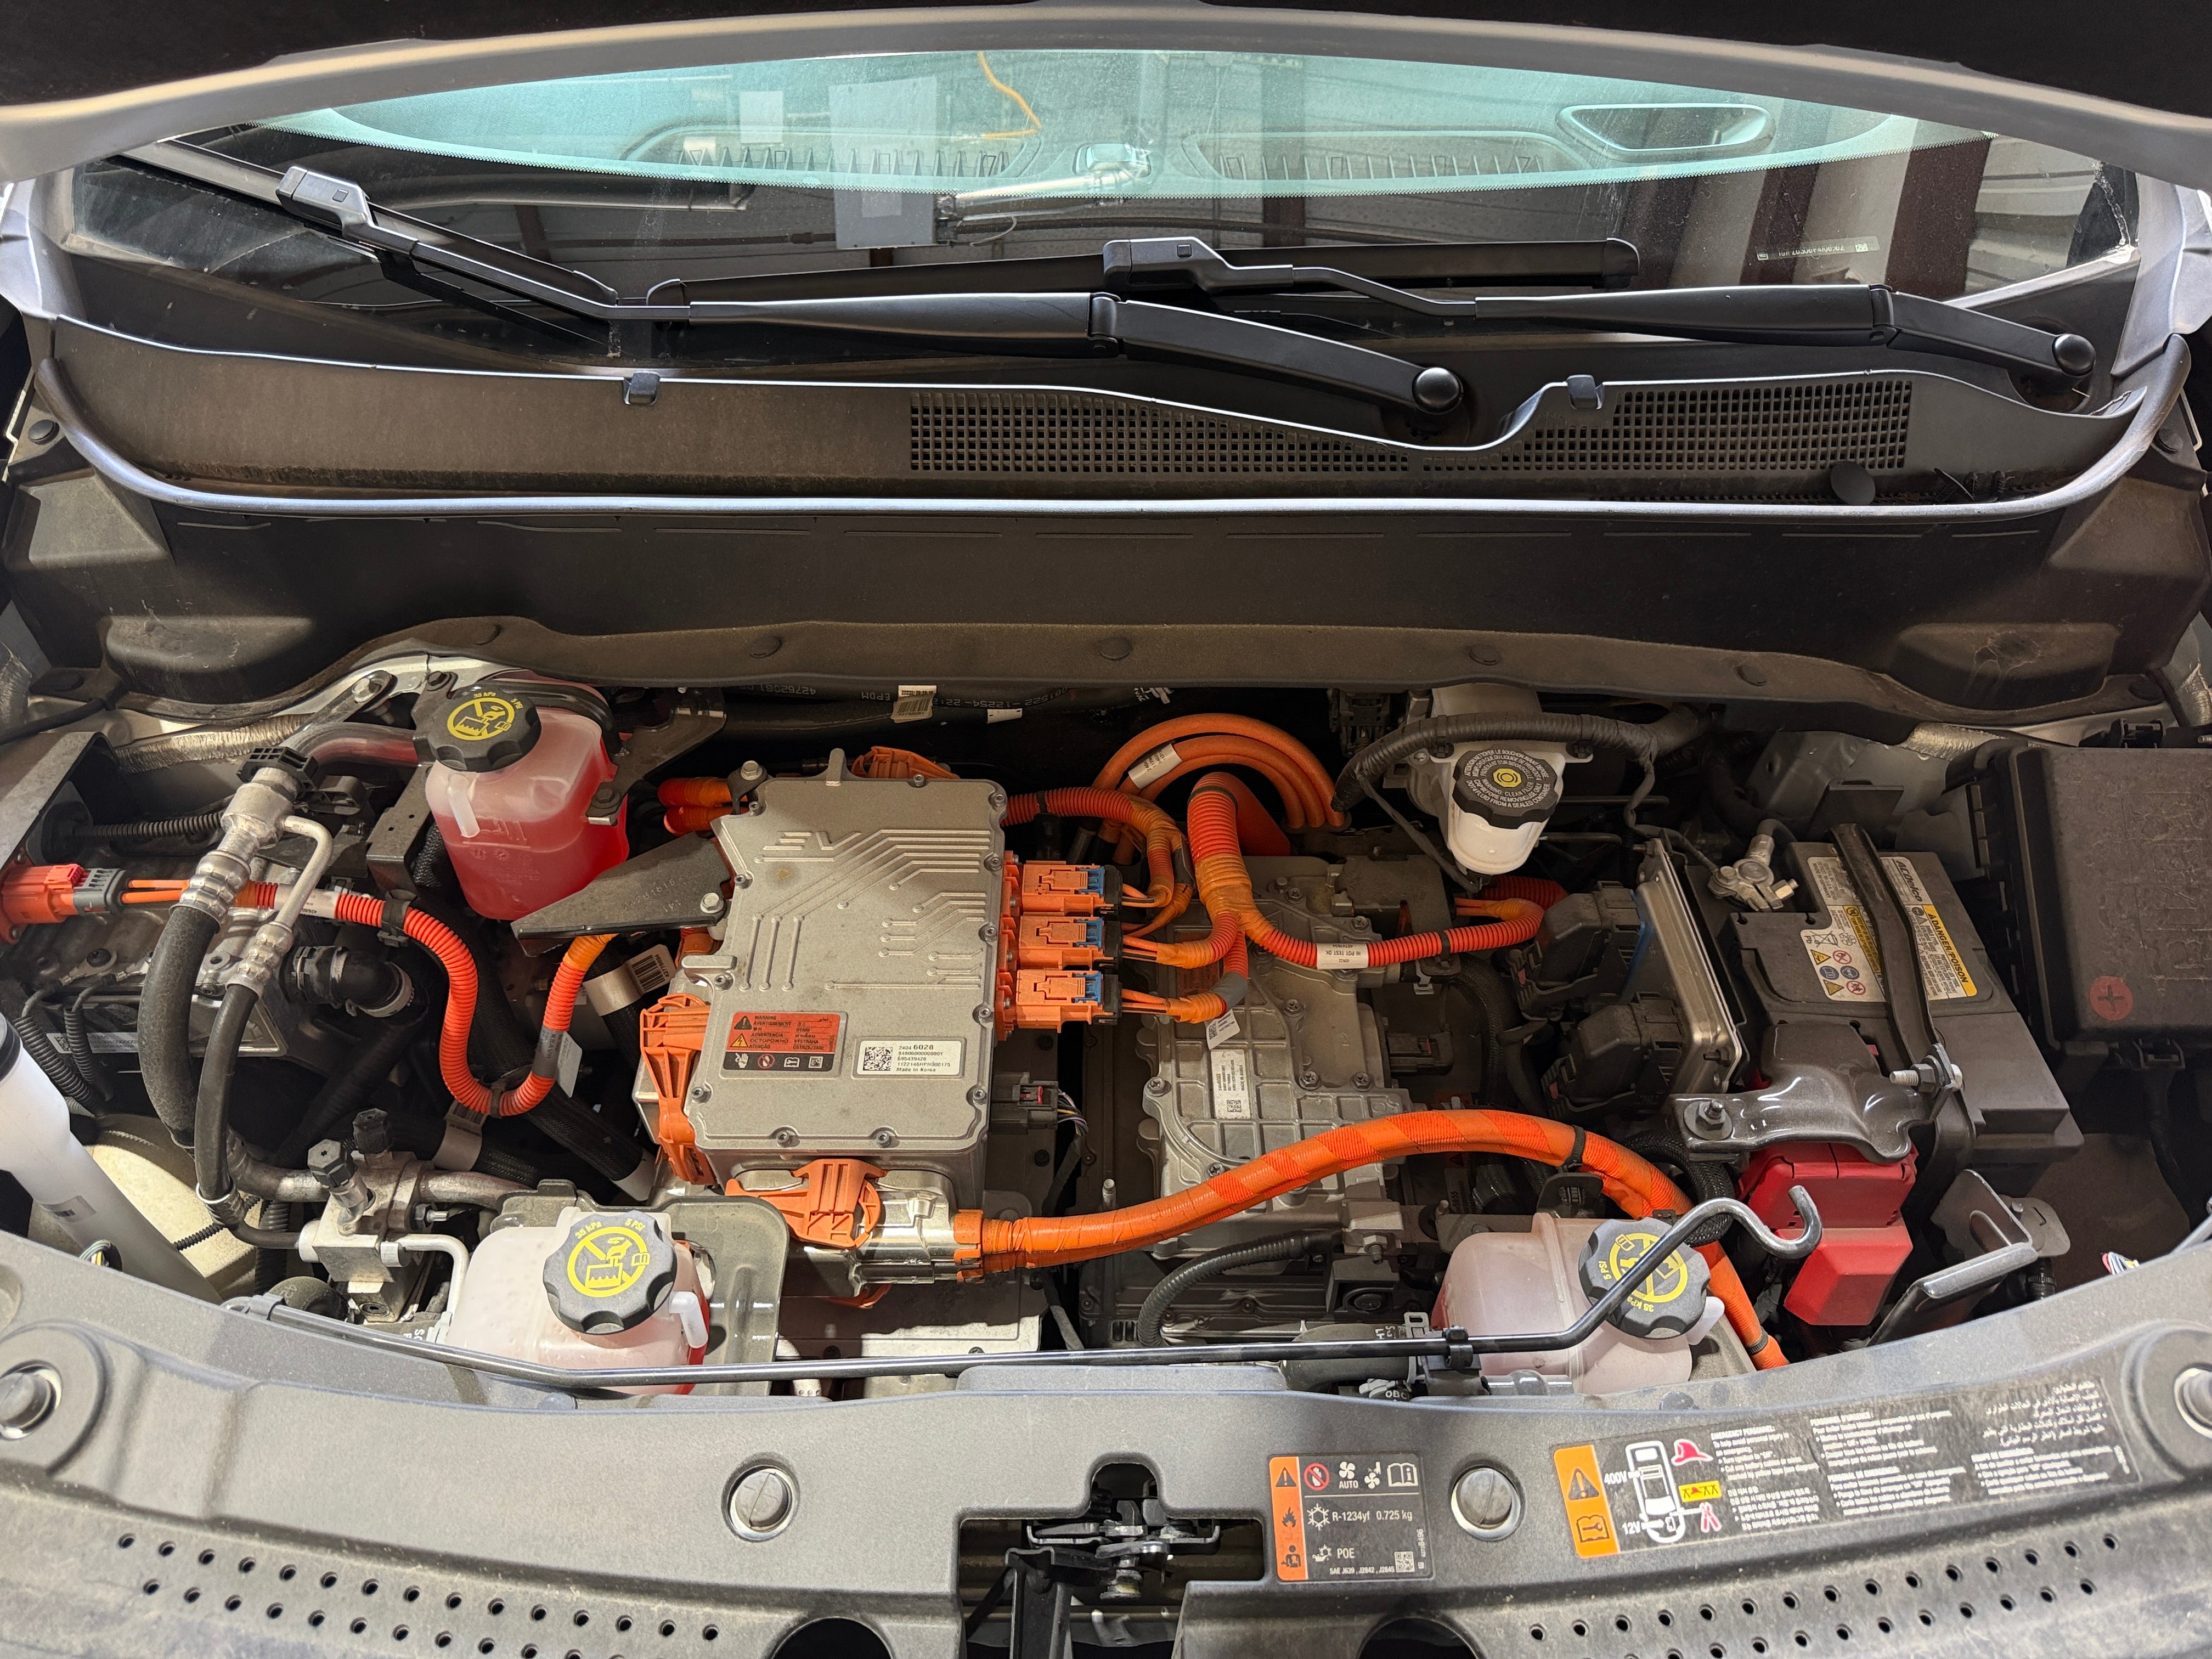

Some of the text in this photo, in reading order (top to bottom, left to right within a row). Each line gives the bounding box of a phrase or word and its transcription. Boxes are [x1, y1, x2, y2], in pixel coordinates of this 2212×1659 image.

[861, 691, 890, 701] EPDM
[1475, 790, 1490, 801] FLUID
[1489, 799, 1508, 807] FROM
[1896, 860, 1923, 902] ACDelco
[1804, 935, 1812, 944] Pb
[1932, 919, 1969, 983] DANGER/POISON
[575, 1218, 646, 1239] 35 kPa 5 PSI
[1599, 1261, 1609, 1273] PSI
[1627, 1296, 1642, 1309] kPa
[1644, 1303, 1654, 1312] 35
[1385, 1390, 1409, 1399] OBC
[1604, 1471, 1627, 1485] 400V
[1339, 1481, 1358, 1489] AUTO
[1332, 1510, 1413, 1523] R-1234yf 0.725 kg
[1622, 1521, 1640, 1535] 12V
[1337, 1548, 1356, 1559] POE
